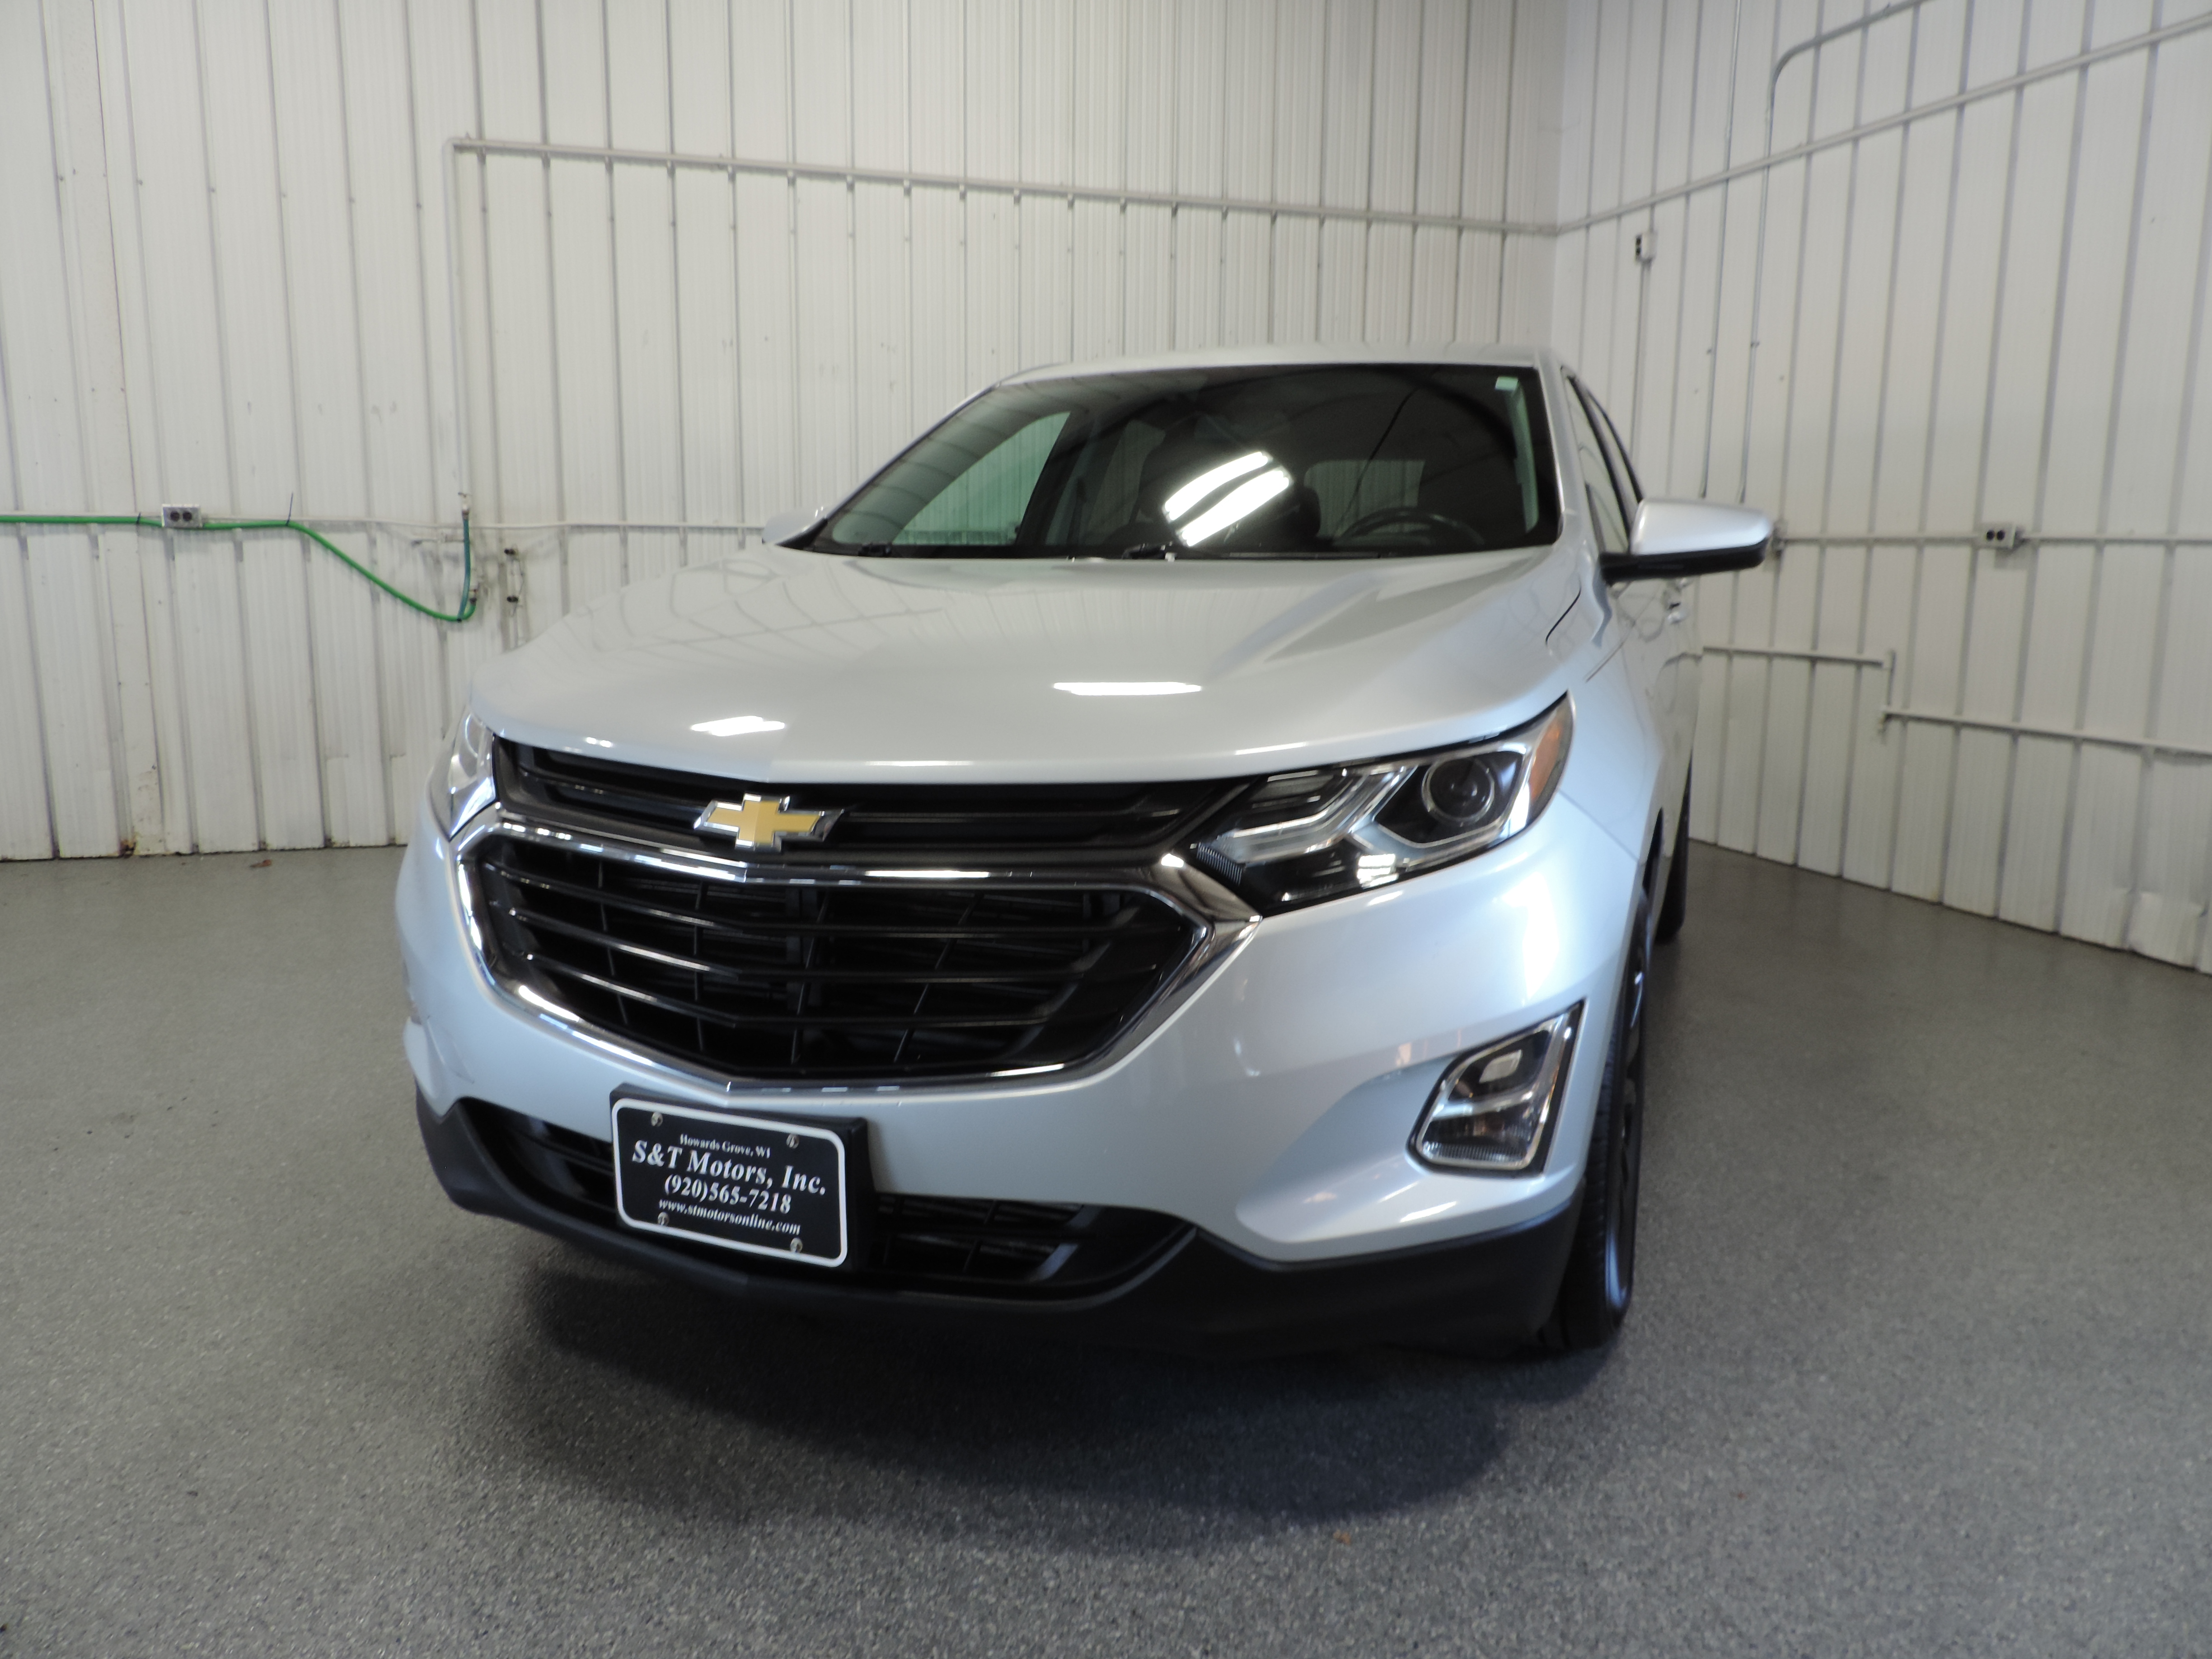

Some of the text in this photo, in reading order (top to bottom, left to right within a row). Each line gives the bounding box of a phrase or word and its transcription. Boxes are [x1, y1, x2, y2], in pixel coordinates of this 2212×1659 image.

[680, 1134, 720, 1151] Howards
[755, 1146, 770, 1159] WI
[632, 1140, 826, 1195] S&T Motors, Inc.
[665, 1174, 792, 1214] (920)565-7218
[659, 1199, 801, 1235] www.stmotorsonline.com
